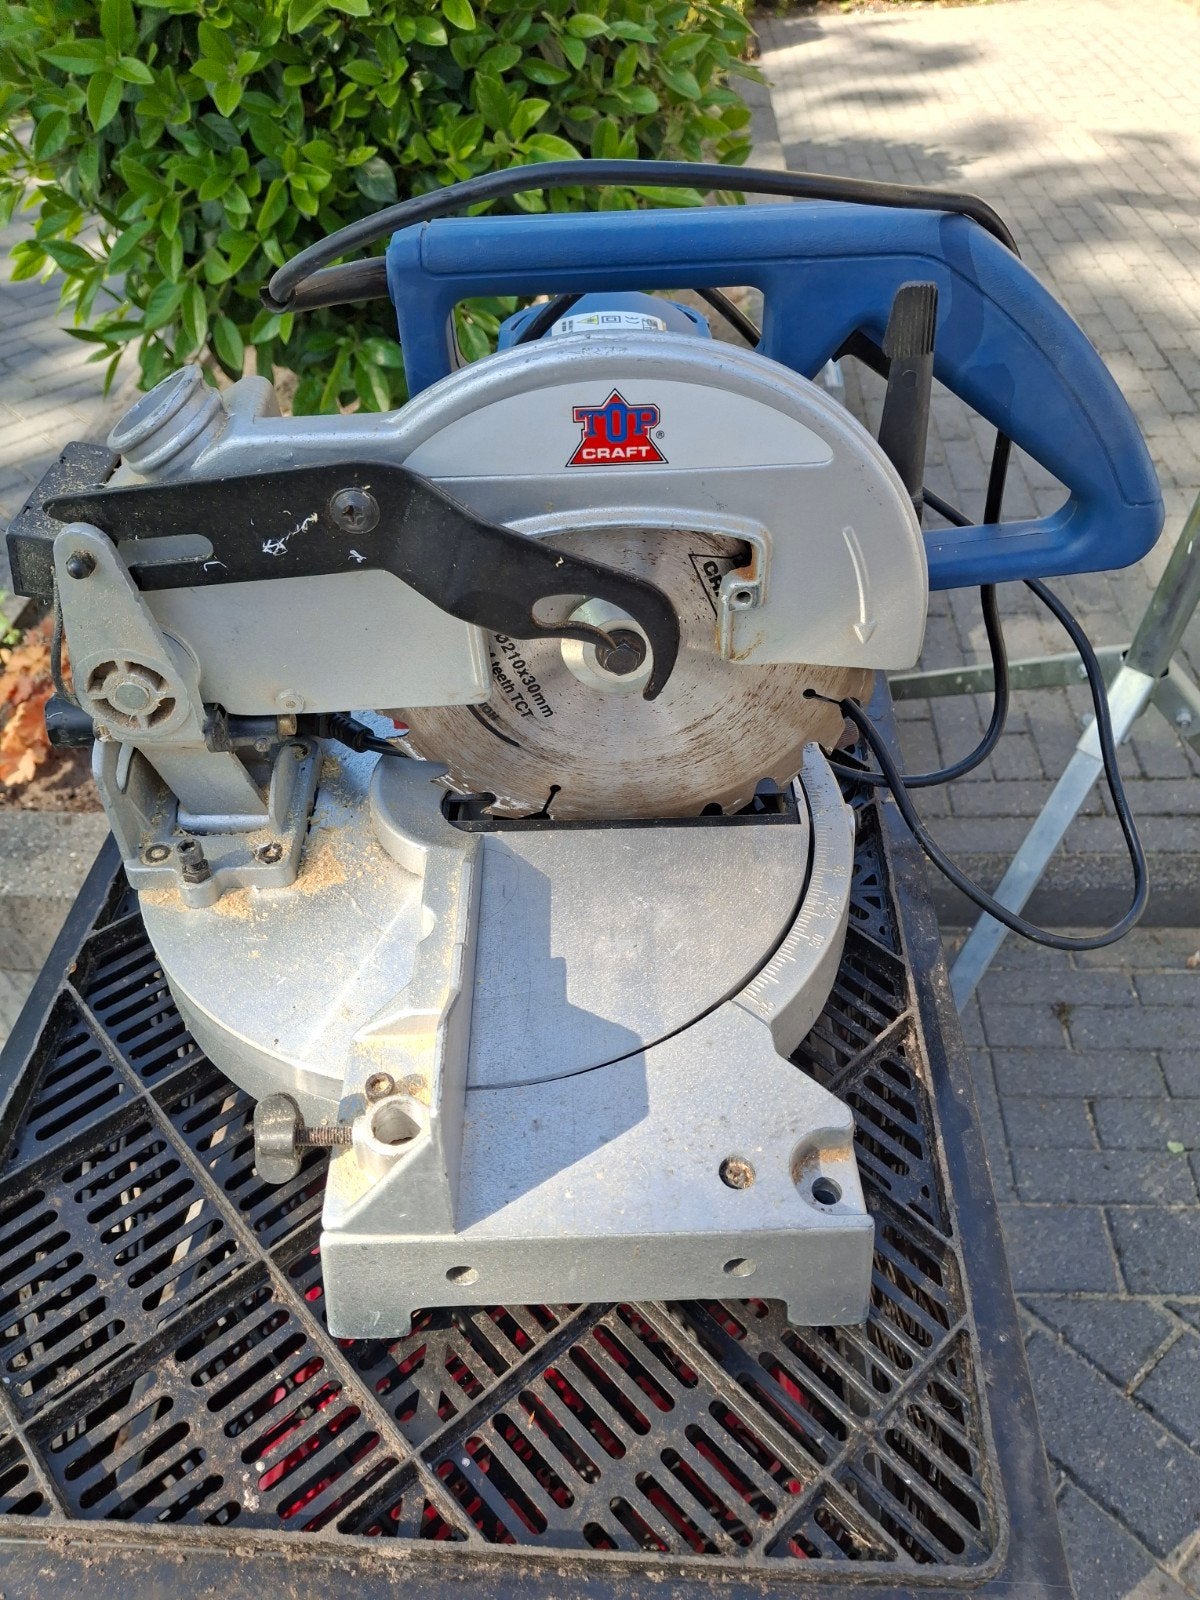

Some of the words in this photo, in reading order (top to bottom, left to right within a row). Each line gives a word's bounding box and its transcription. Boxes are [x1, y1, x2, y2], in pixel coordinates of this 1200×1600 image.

[578, 402, 657, 443] TOP
[582, 446, 650, 459] CRAFT
[510, 692, 535, 718] TCT
